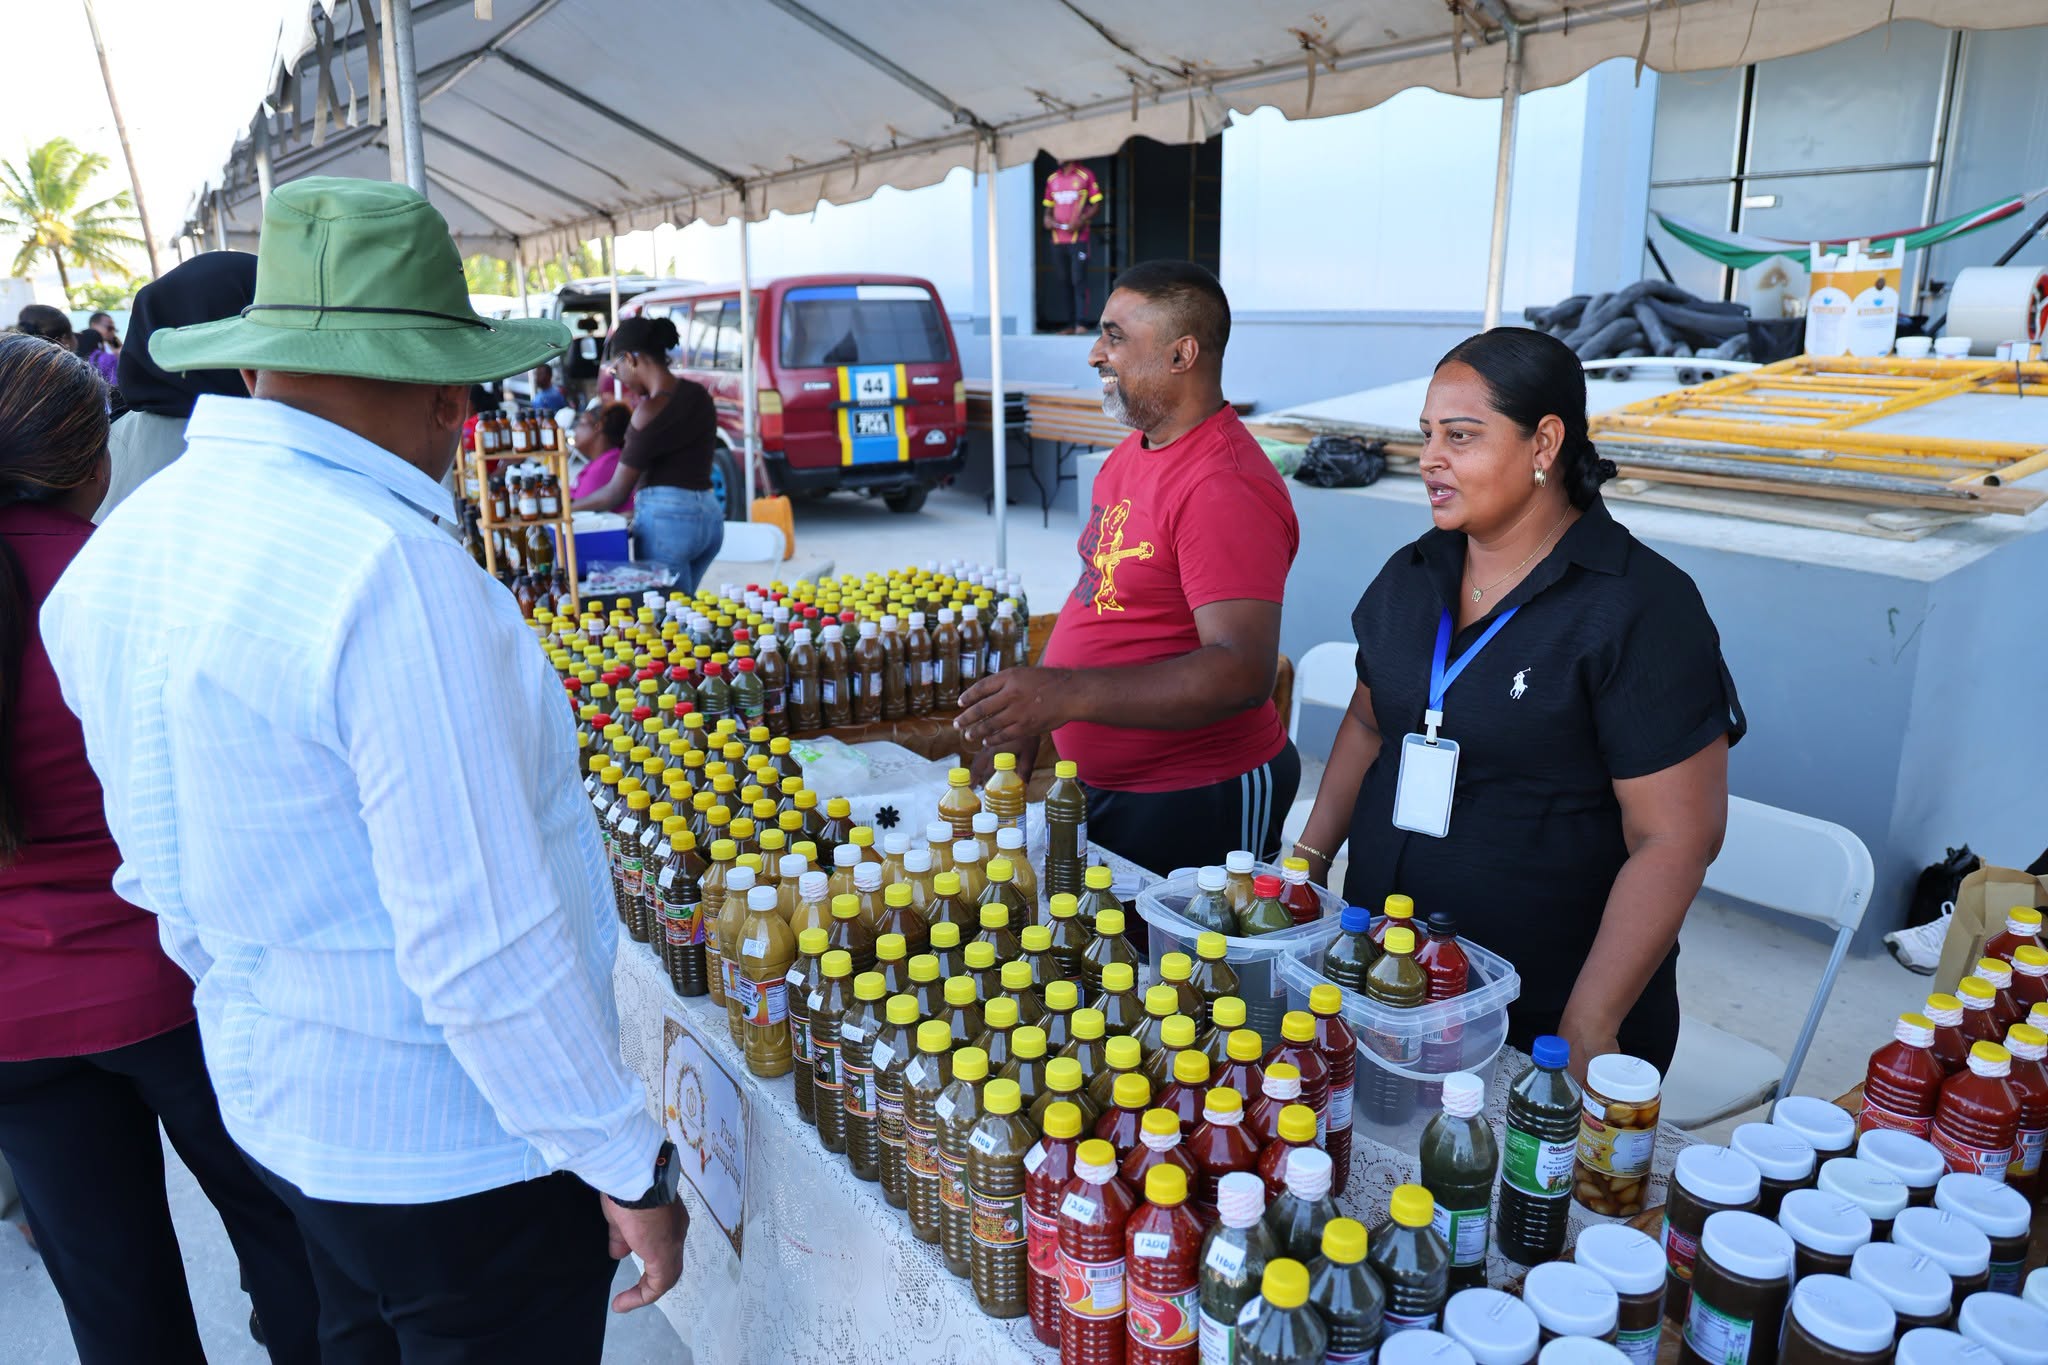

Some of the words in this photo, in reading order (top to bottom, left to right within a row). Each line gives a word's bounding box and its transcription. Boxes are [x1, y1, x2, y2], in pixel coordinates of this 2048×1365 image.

[863, 378, 883, 393] 44
[721, 1117, 737, 1153] Free
[975, 1135, 990, 1148] 1100
[712, 1132, 741, 1193] Sampling
[1141, 1238, 1167, 1250] 1200
[1215, 1254, 1236, 1271] 1100
